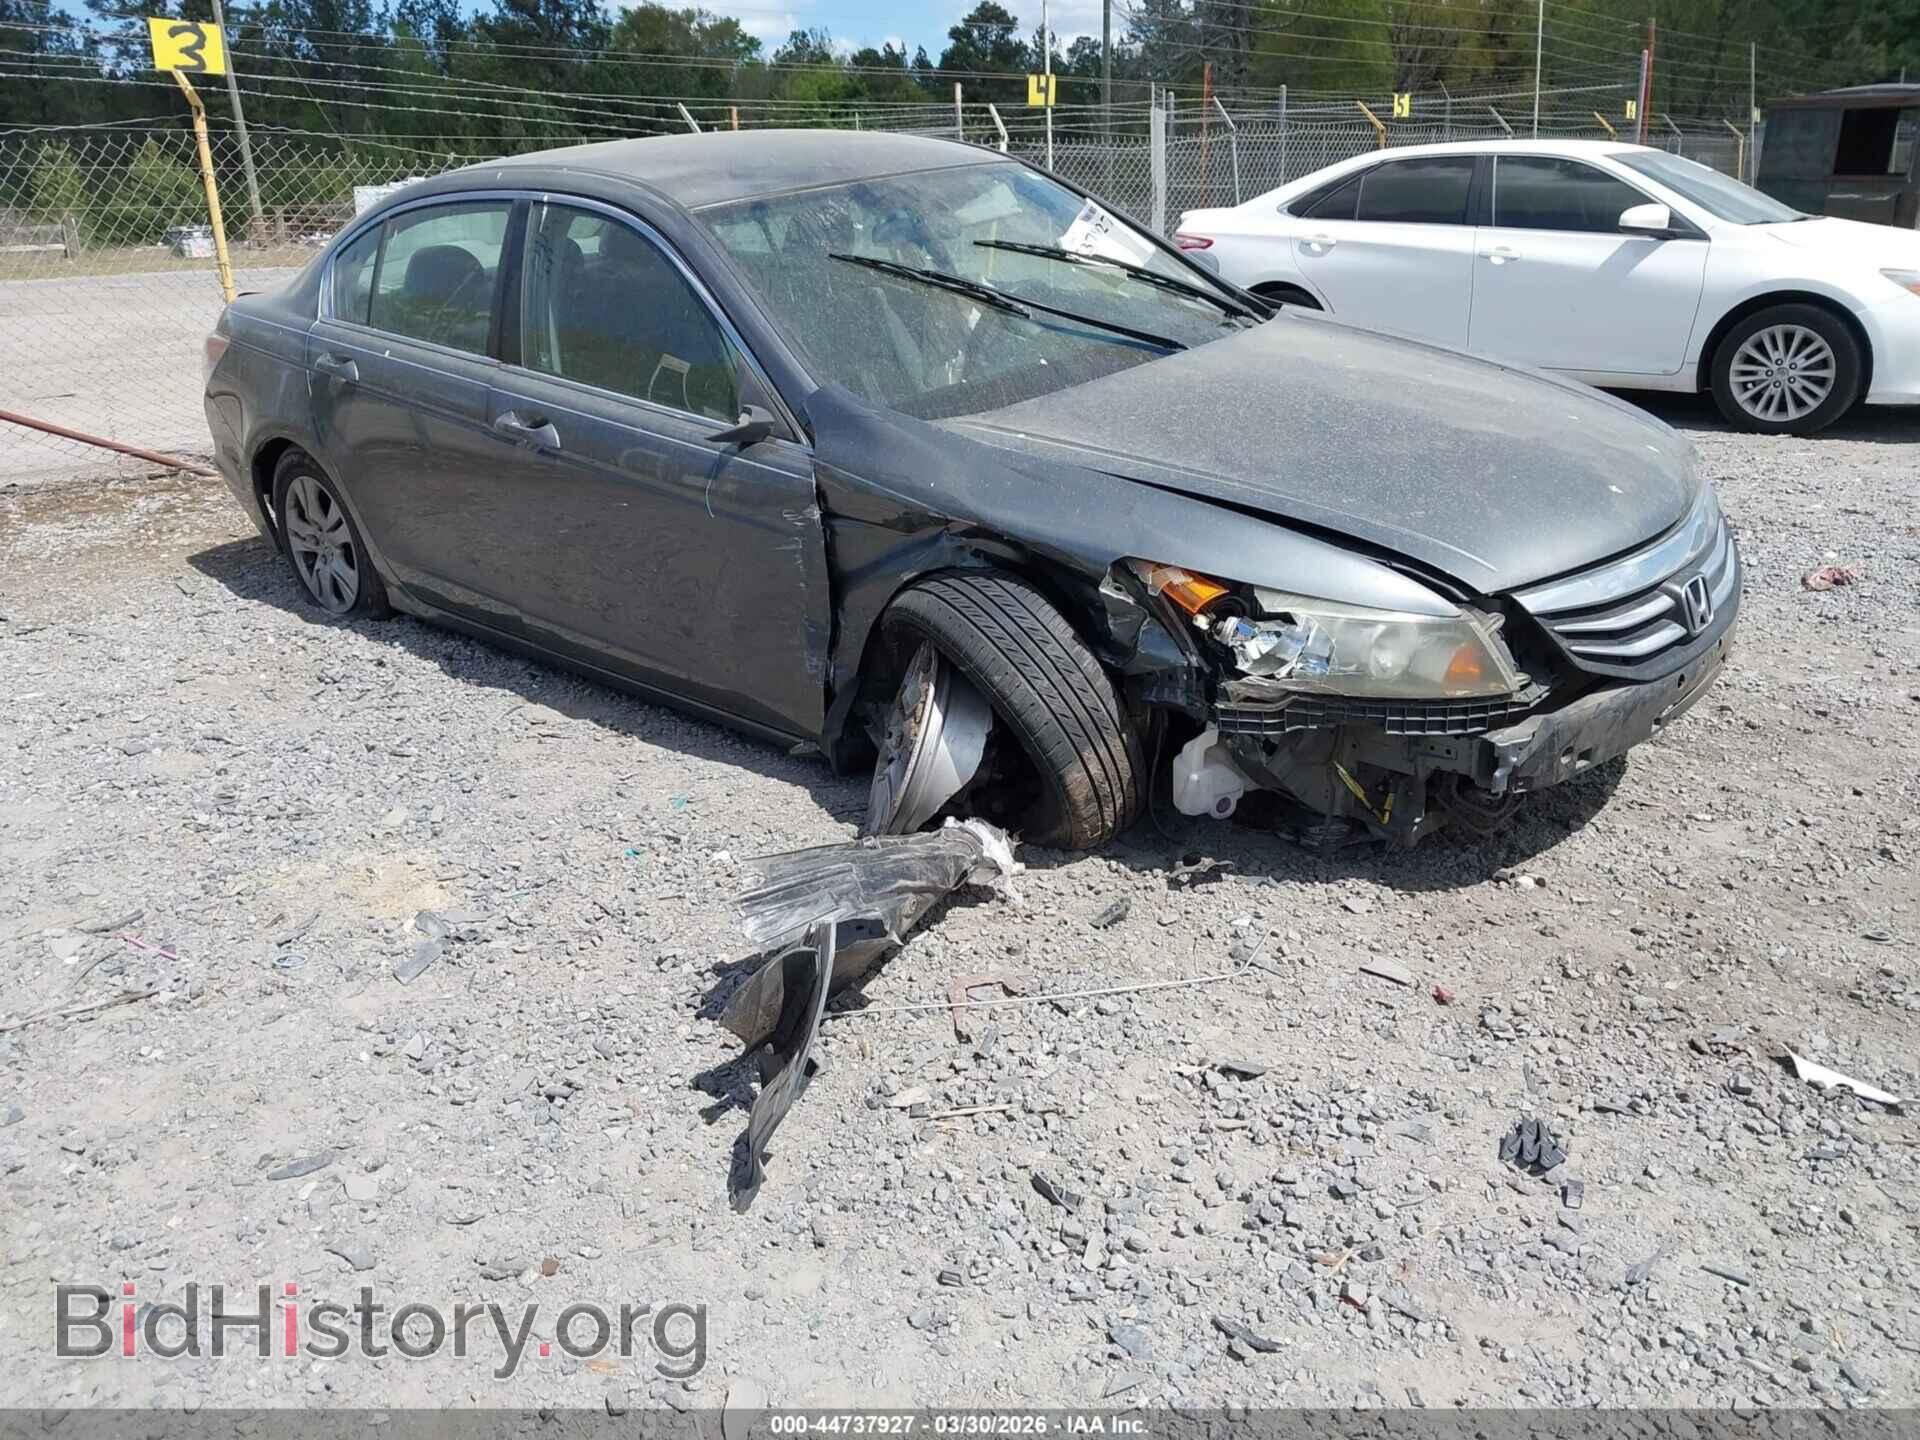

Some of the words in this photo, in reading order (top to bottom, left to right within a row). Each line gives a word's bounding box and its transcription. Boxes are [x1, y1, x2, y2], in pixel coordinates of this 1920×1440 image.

[168, 22, 207, 71] 3
[1036, 75, 1049, 105] 4
[1396, 94, 1405, 116] 5
